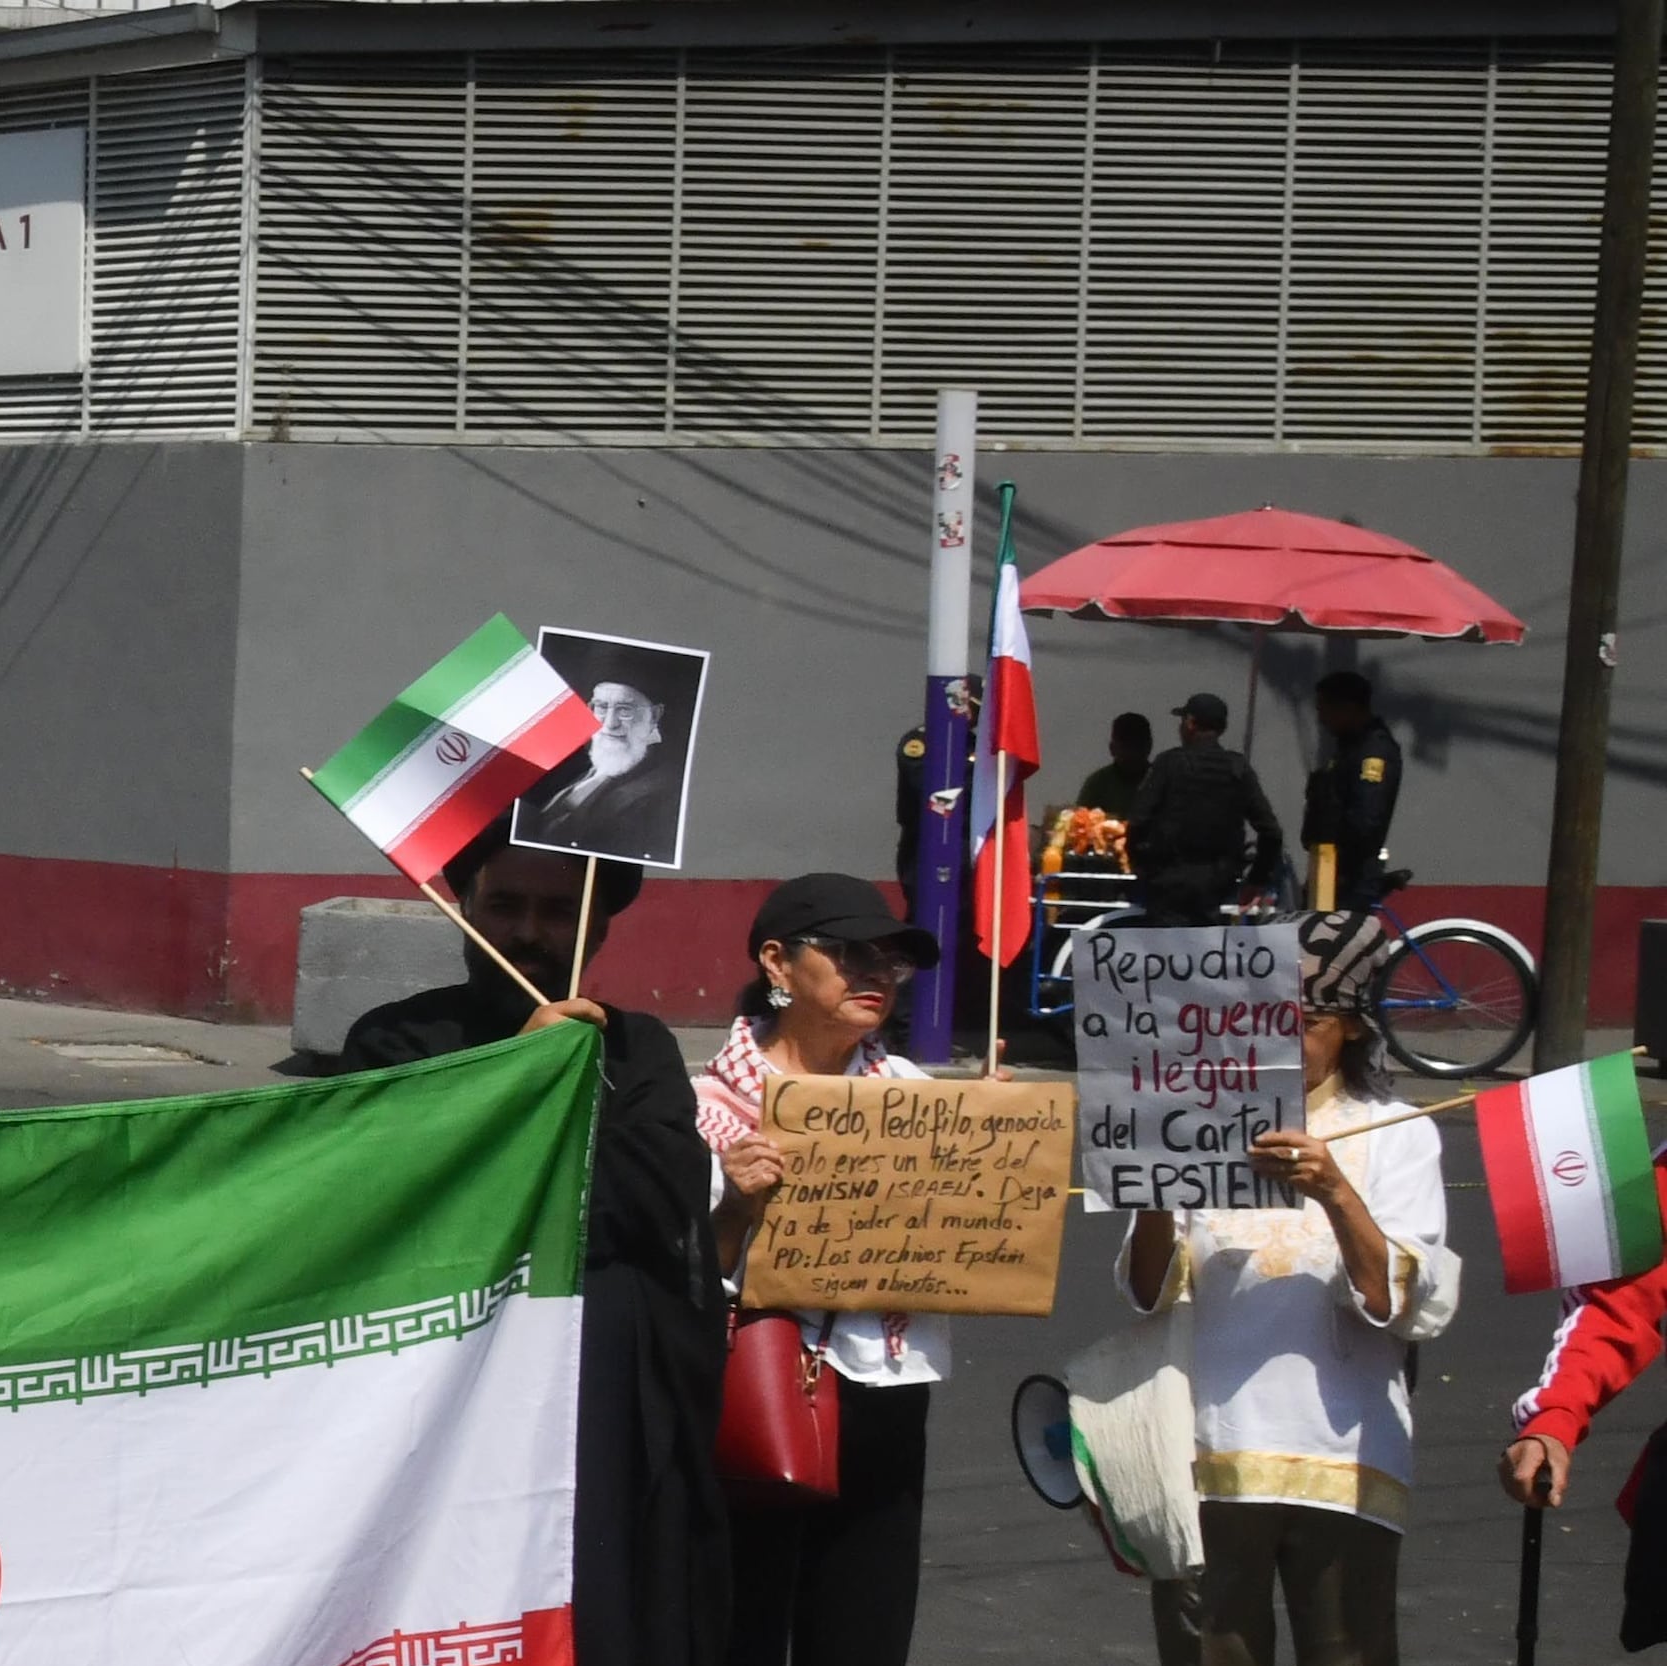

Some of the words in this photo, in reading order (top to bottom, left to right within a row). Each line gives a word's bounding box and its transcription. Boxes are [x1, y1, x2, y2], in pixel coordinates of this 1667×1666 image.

[19, 214, 31, 249] 1
[1088, 928, 1275, 1003] Repudio
[1082, 1012, 1109, 1038] a
[1125, 1002, 1159, 1039] la
[1177, 1000, 1302, 1057] guerra
[1131, 1043, 1259, 1110] ilegal
[771, 1080, 871, 1145] Cerdo,
[1091, 1105, 1137, 1150] del
[1161, 1096, 1282, 1153] Cartel
[779, 1141, 827, 1175] olo
[835, 1154, 886, 1175] eres
[893, 1154, 917, 1172] un
[993, 1140, 1040, 1171] del
[993, 1175, 1057, 1210] Deja
[807, 1206, 831, 1234] de
[835, 1205, 899, 1242] joder
[905, 1198, 933, 1229] al
[941, 1202, 1022, 1230] mundo.
[858, 1235, 946, 1265] archivos
